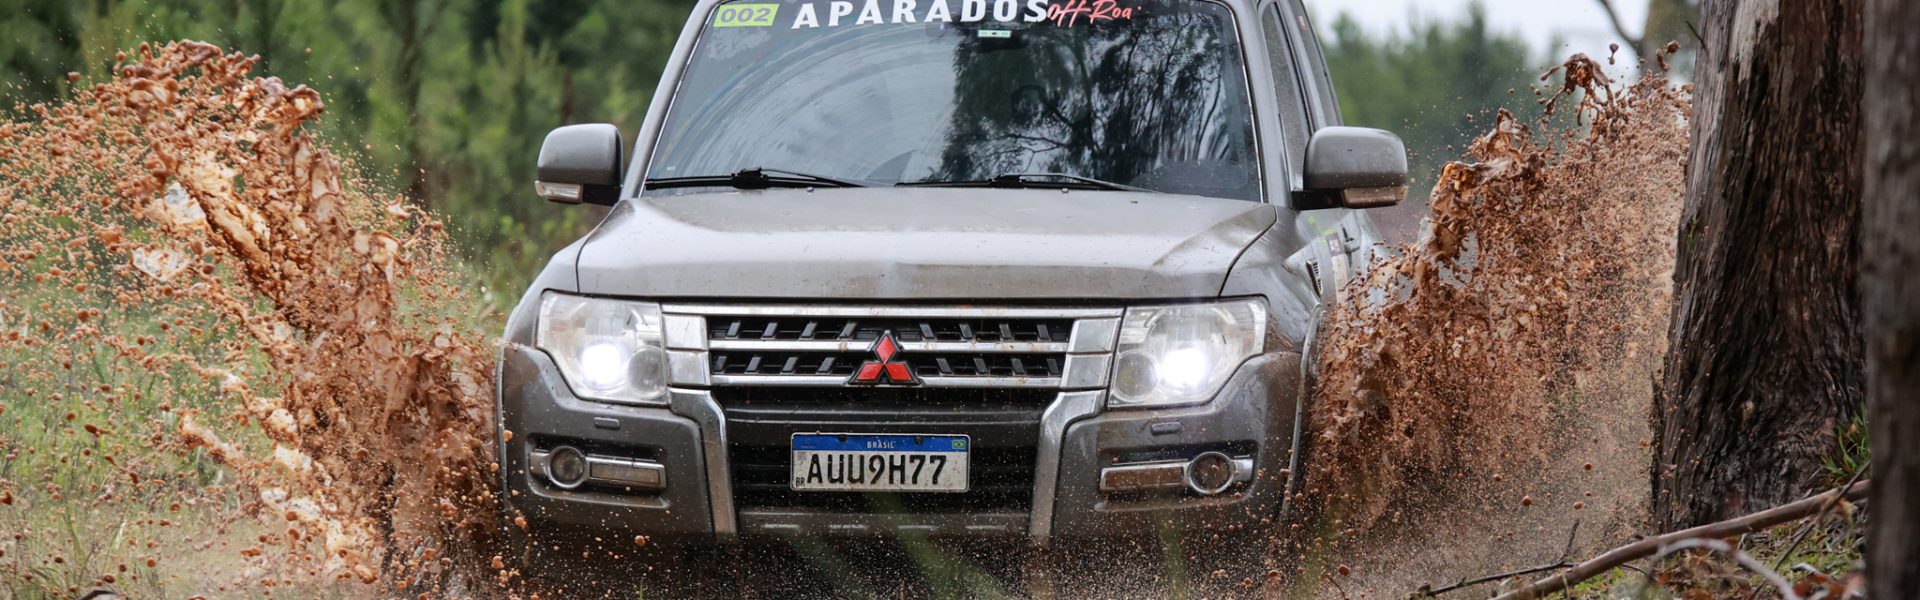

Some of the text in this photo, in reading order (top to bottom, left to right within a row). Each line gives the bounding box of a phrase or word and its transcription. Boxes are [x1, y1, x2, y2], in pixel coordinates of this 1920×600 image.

[720, 7, 771, 23] 002
[790, 0, 1049, 29] APARADOS
[867, 440, 895, 449] BRASIL
[807, 454, 947, 485] AUU9H77
[795, 476, 806, 487] BR
